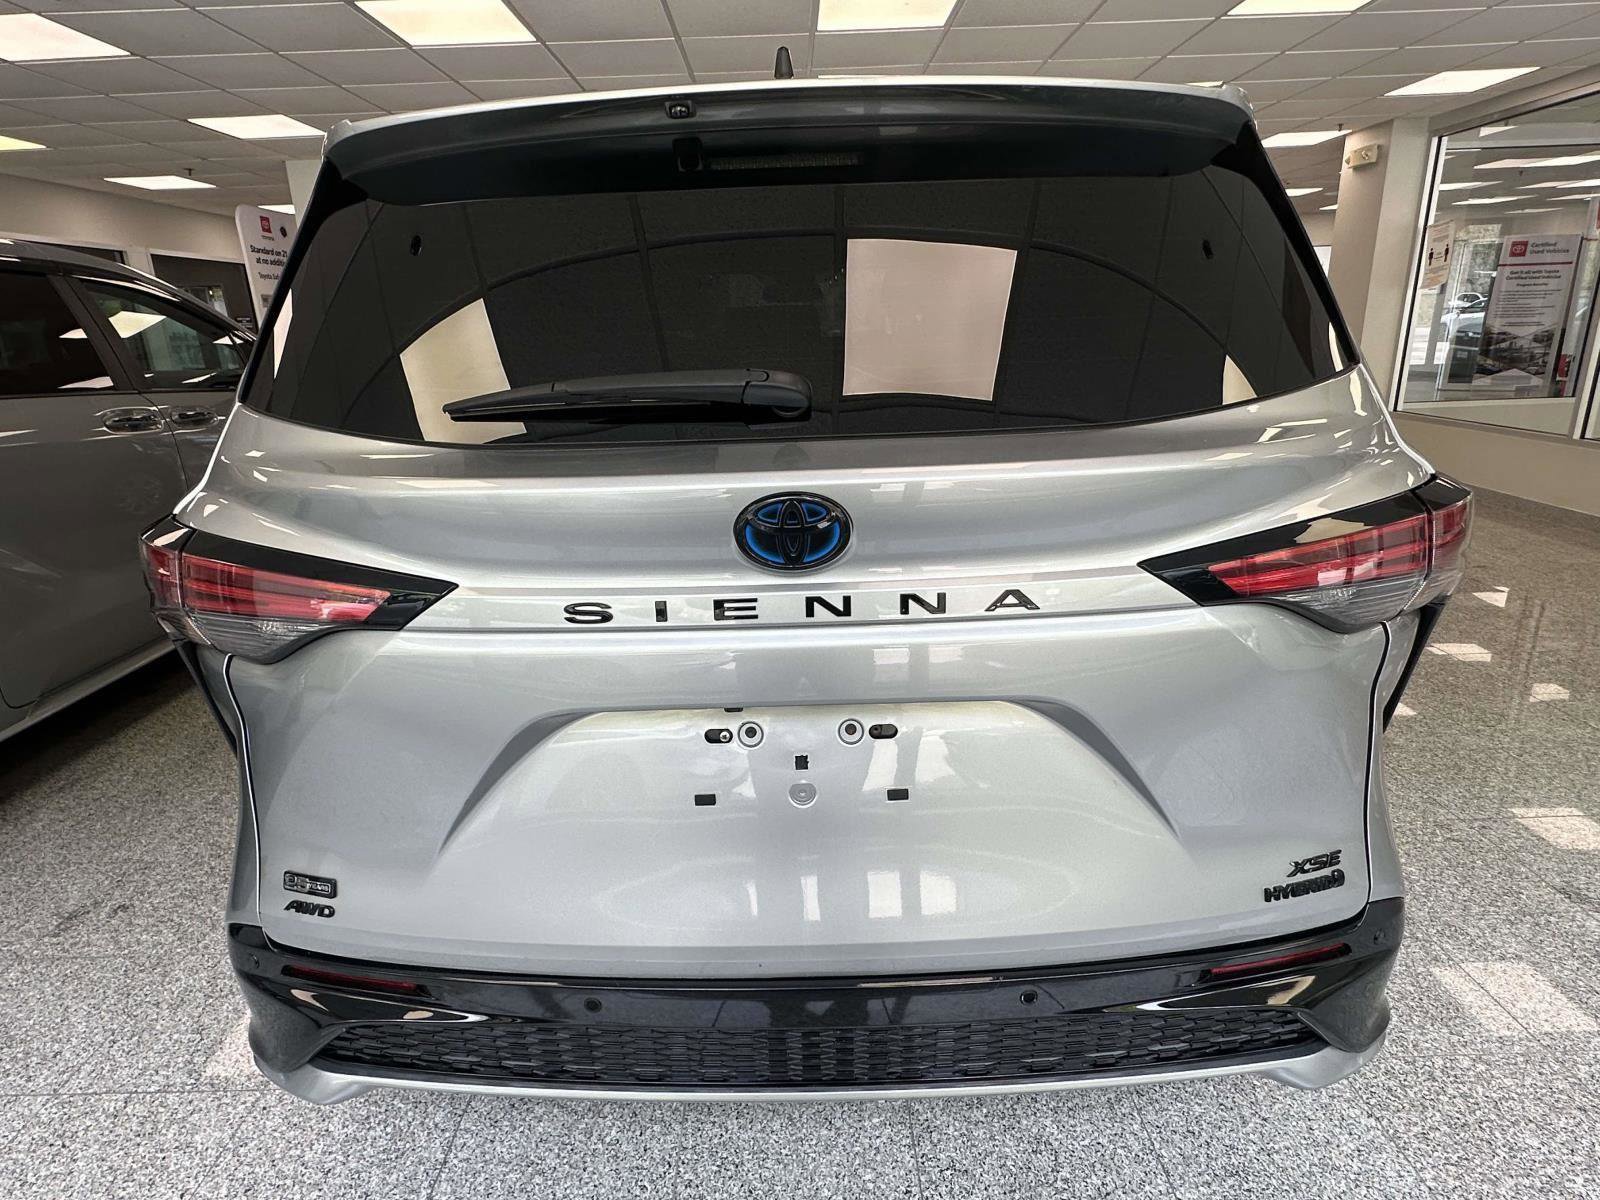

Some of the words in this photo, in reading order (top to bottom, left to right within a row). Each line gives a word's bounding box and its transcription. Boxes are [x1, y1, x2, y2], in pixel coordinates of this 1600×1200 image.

[250, 245, 274, 256] Standard
[563, 588, 1040, 624] SIENNA
[1286, 849, 1342, 877] XSE
[1264, 869, 1345, 902] HYBRID
[283, 899, 335, 918] AWD
